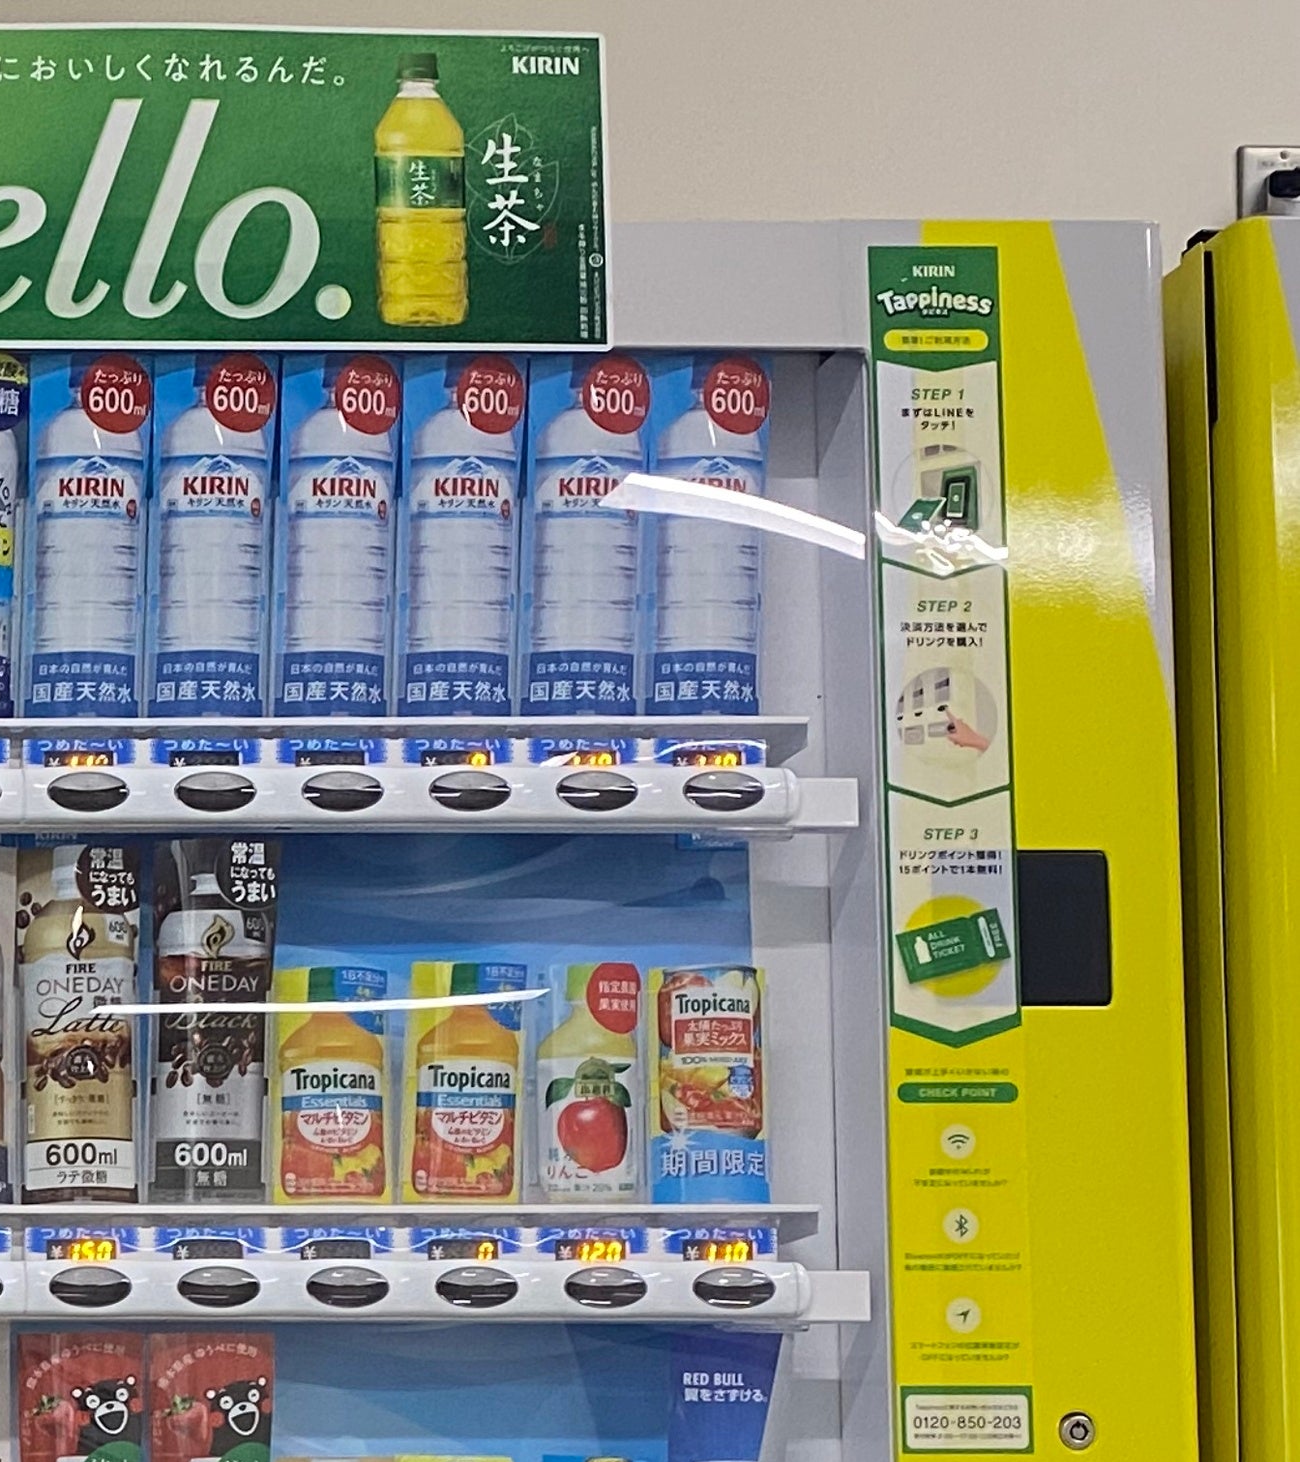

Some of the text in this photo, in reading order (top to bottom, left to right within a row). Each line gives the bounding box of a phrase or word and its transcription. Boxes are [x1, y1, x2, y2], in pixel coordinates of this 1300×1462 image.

[512, 57, 579, 75] KIRIN
[409, 160, 436, 205] 生茶
[481, 133, 540, 246] 生茶
[912, 265, 955, 277] KIRIN
[876, 286, 993, 317] Tappiness
[912, 389, 965, 400] STEP 1
[59, 478, 125, 498] KIRIN
[917, 601, 971, 612] STEP 2
[33, 682, 132, 704] 国産天然水
[924, 829, 978, 840] STEP 3
[230, 882, 276, 903] うまい
[66, 964, 96, 974] FIRE
[675, 993, 750, 1014] Tropicana
[291, 1068, 375, 1093] Tropicana
[661, 1149, 766, 1177] 期間限定
[683, 1372, 744, 1386] RED BULL
[913, 1417, 1021, 1429] 0120-850-203
